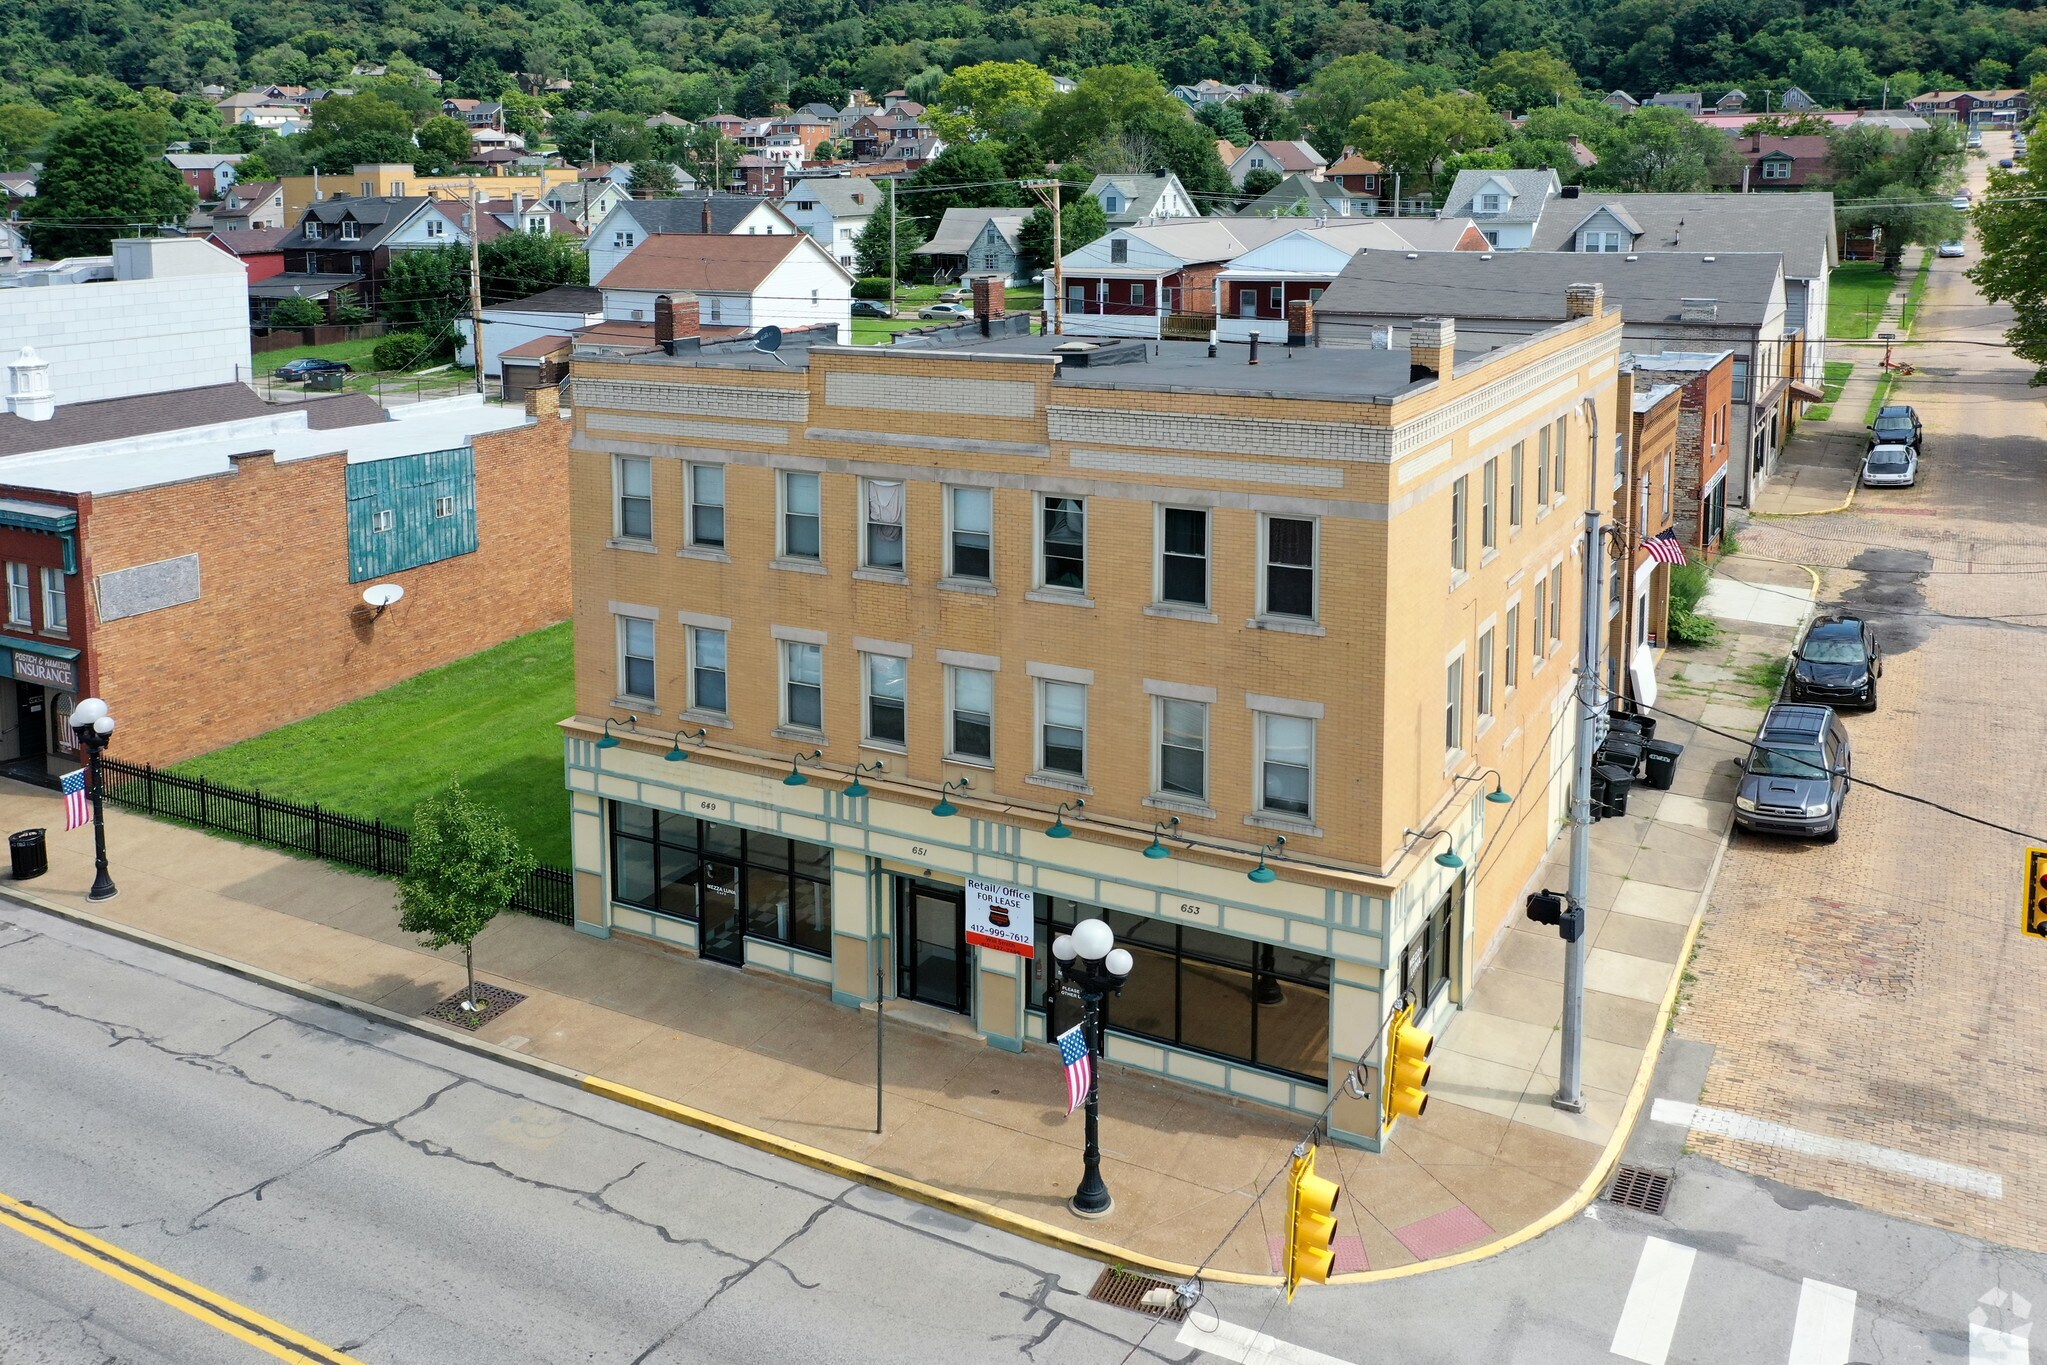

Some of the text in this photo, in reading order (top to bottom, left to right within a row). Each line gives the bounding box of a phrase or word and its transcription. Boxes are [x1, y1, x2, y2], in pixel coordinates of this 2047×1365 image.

[38, 658, 44, 666] &
[44, 659, 71, 671] HAMILTON
[15, 660, 73, 685] INSURANCE
[701, 801, 716, 811] 649
[912, 846, 928, 856] 651
[723, 887, 737, 896] LUNA
[968, 879, 1031, 901] Retail/ Office
[977, 892, 1021, 909] FOR LEASE
[1180, 903, 1201, 915] 653
[970, 923, 1030, 944] 412-999-7612
[1060, 990, 1077, 998] OTHER
[1061, 985, 1080, 994] PLEASE
